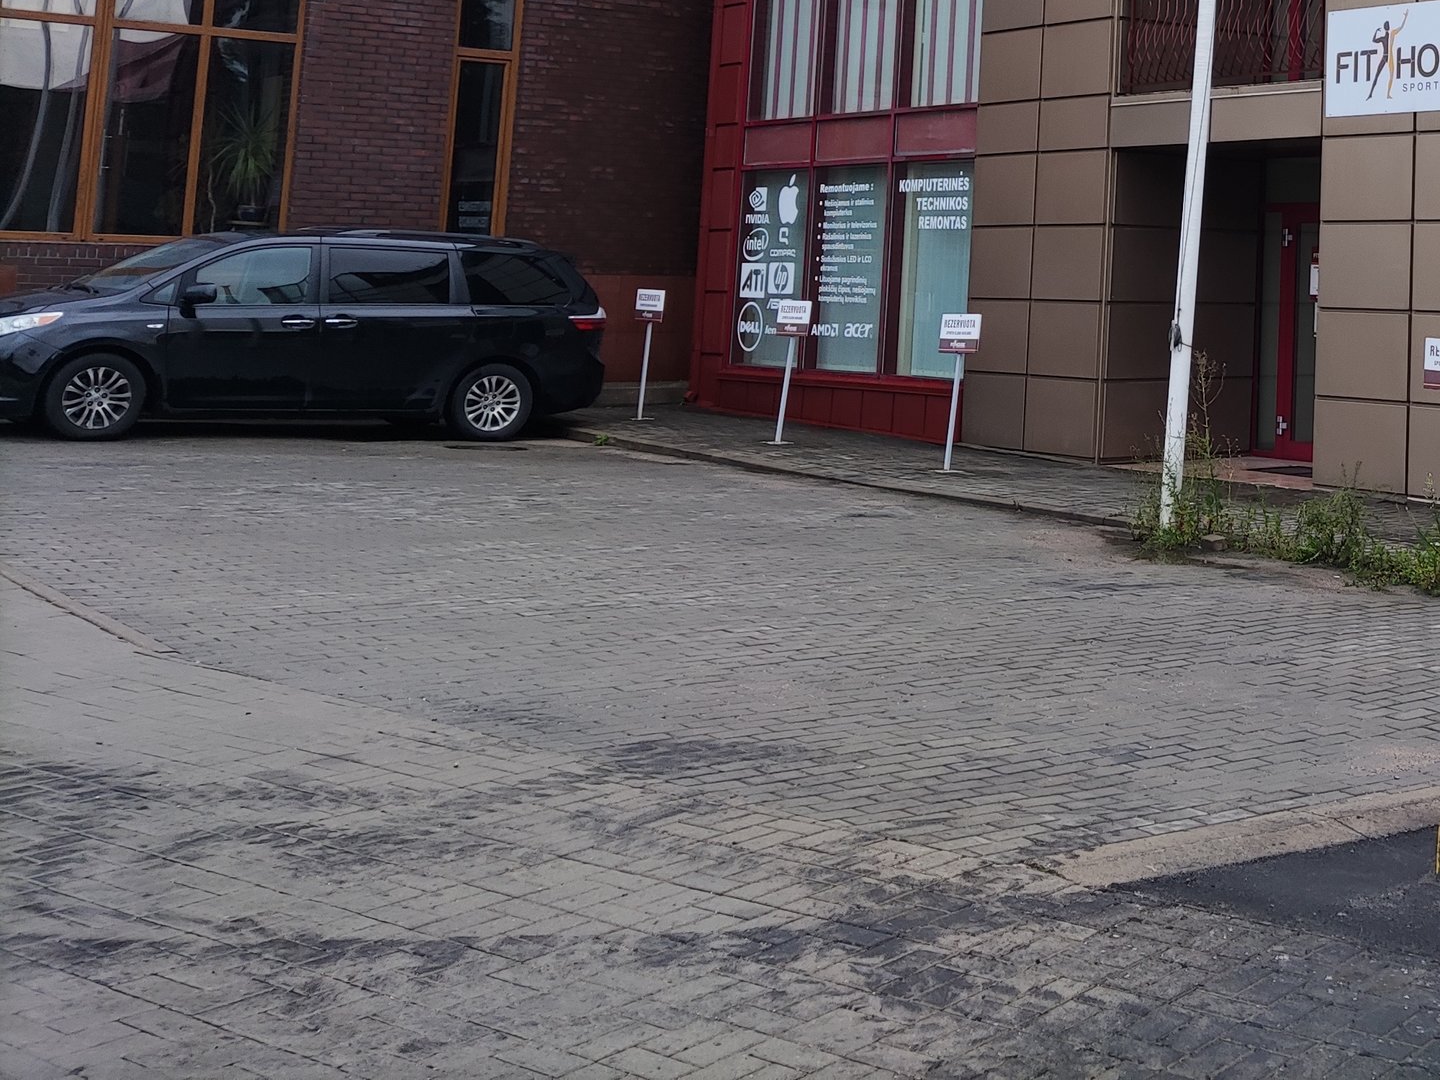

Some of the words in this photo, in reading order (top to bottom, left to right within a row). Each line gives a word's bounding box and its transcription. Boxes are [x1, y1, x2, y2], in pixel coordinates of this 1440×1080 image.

[1336, 49, 1377, 84] FIT
[899, 171, 970, 192] KOMPIUTERINĖS
[916, 196, 968, 211] TECHNIKOS
[918, 216, 967, 230] REMONTAS
[746, 235, 765, 250] intel
[740, 321, 760, 334] DELL
[811, 324, 832, 336] AMD
[844, 323, 873, 339] acer
